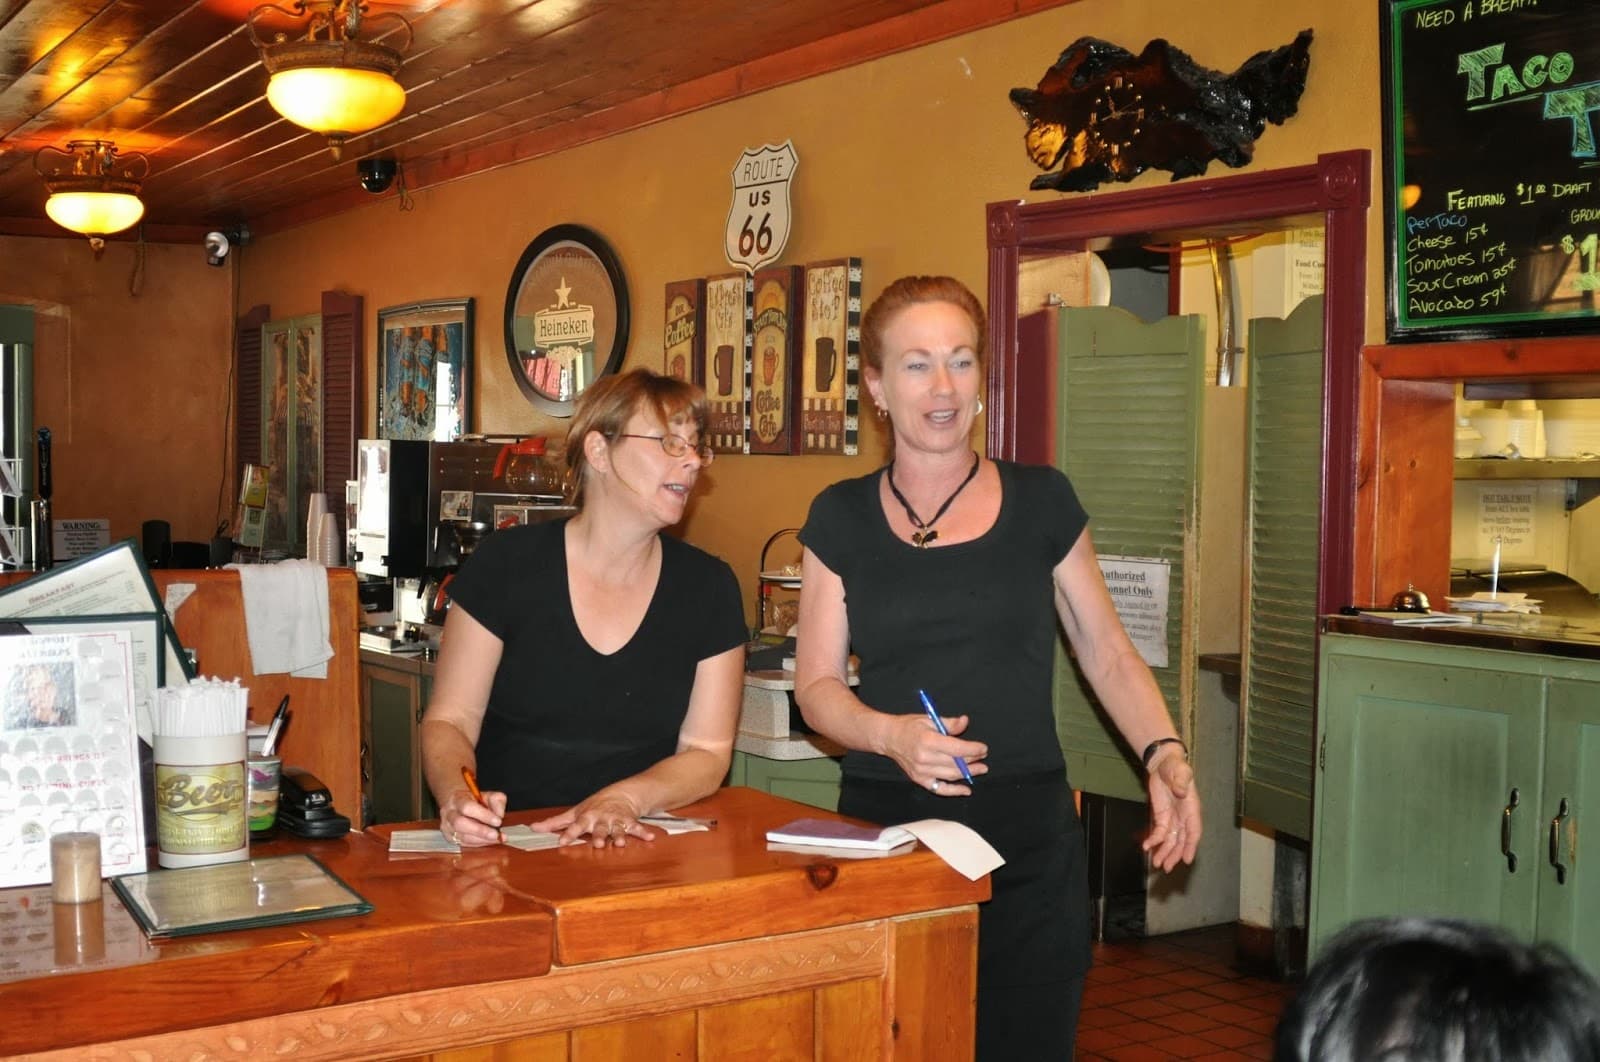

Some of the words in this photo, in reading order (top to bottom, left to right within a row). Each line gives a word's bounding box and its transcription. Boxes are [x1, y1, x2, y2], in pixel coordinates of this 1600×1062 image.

[1416, 10, 1455, 28] NEED
[1464, 4, 1473, 21] A
[1457, 42, 1574, 101] TACO
[744, 156, 784, 182] ROUTE
[749, 189, 771, 207] US
[1552, 182, 1592, 198] DRAFT
[738, 212, 772, 258] 66
[1405, 253, 1475, 275] Tomatoes
[1442, 272, 1489, 289] Cream
[540, 317, 588, 337] Heineken
[665, 317, 696, 347] Coffee
[1133, 586, 1153, 598] Only
[163, 774, 239, 809] Beer
